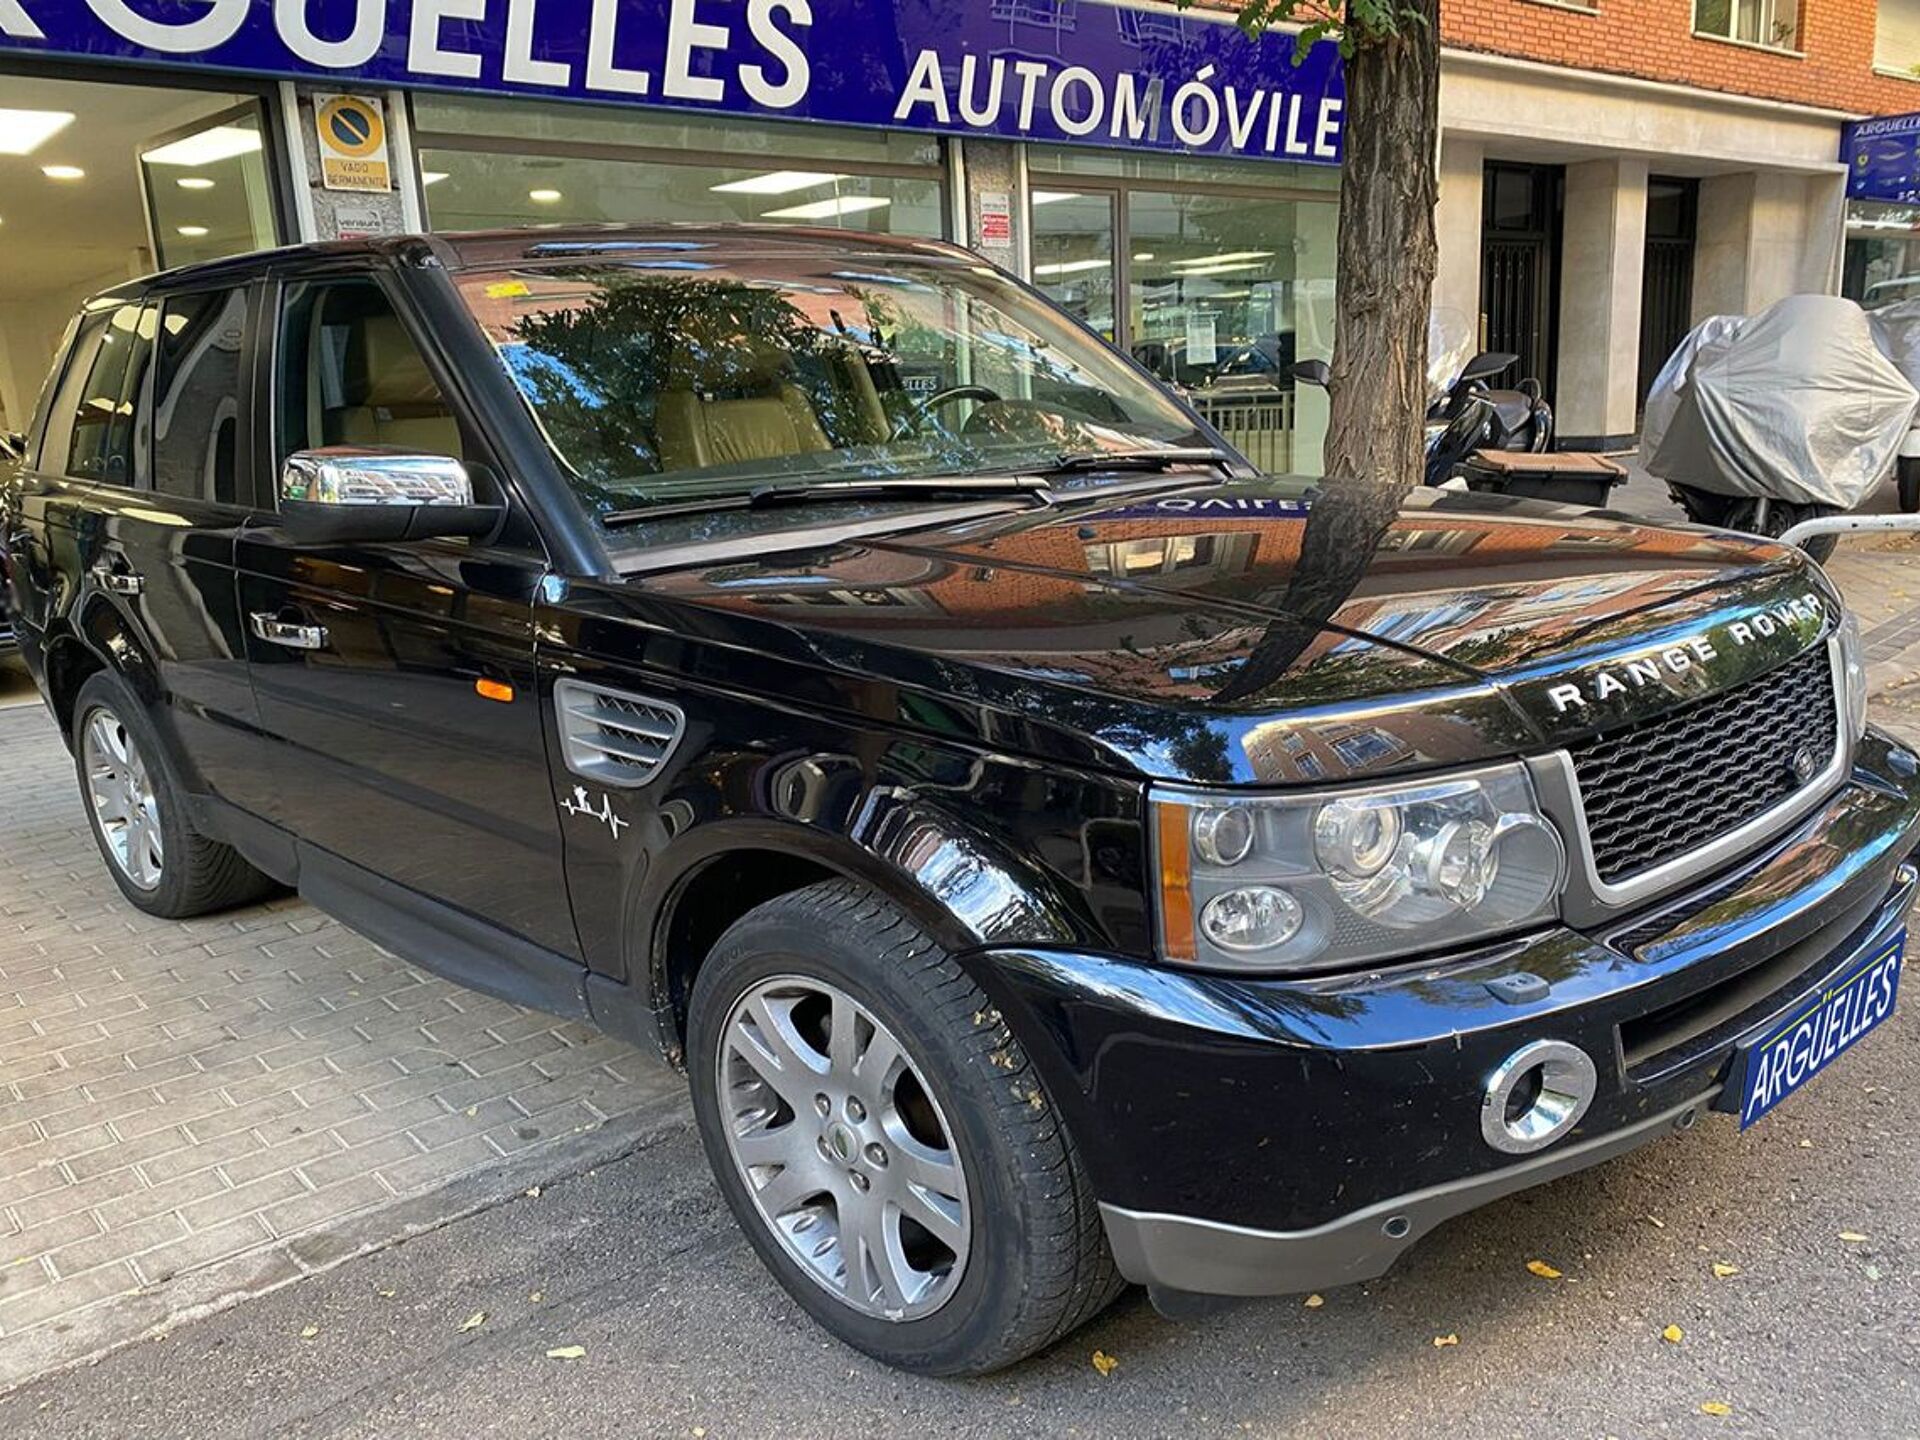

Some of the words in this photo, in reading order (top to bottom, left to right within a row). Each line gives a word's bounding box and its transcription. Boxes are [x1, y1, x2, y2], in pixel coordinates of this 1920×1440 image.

[342, 161, 369, 173] VADO
[1549, 635, 1718, 712] RANGE
[1728, 593, 1823, 646] ROVER
[1745, 954, 1897, 1121] ARGÜELLES
